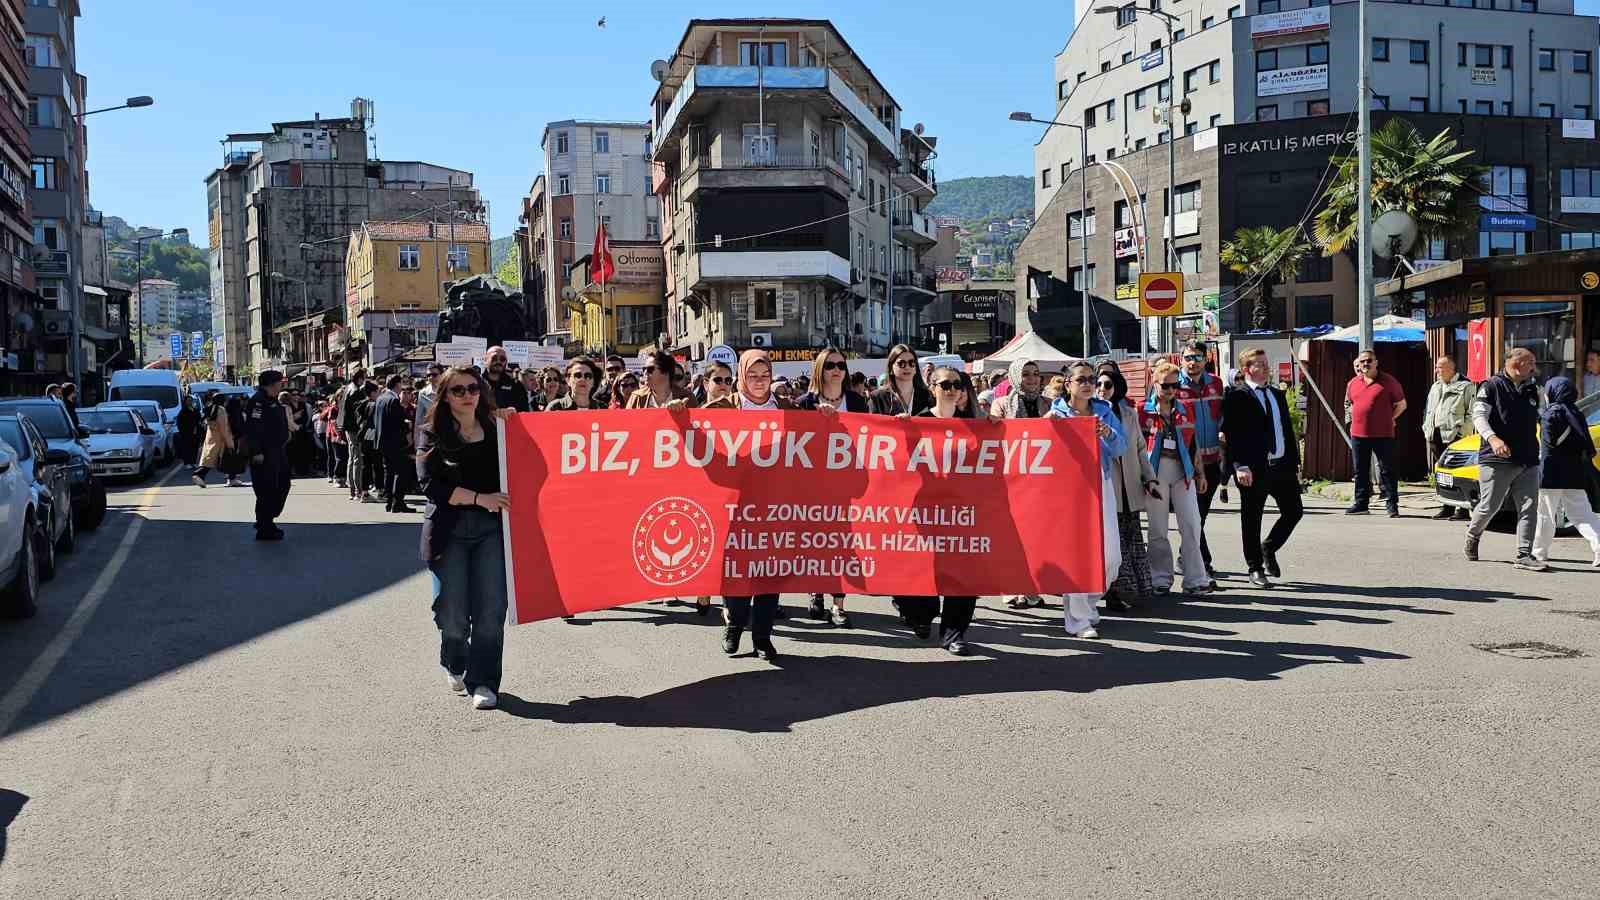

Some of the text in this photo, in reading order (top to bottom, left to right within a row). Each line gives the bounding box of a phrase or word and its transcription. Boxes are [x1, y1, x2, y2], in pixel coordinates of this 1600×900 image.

[1239, 138, 1280, 153] KATLI
[1284, 135, 1298, 152] İŞ
[1302, 131, 1361, 148] MERKE
[1491, 216, 1526, 225] Buderus
[963, 294, 996, 303] Graniser
[560, 423, 1055, 476] BİZ, BÜYÜK BİR AİLEYİZ
[725, 503, 977, 527] T.C. ZONGULDAK VALİLİĞİ
[725, 528, 991, 554] AİLE VE SOSYAL HİZMETLER
[724, 554, 876, 579] İL MÜDÜRLÜĞÜ
